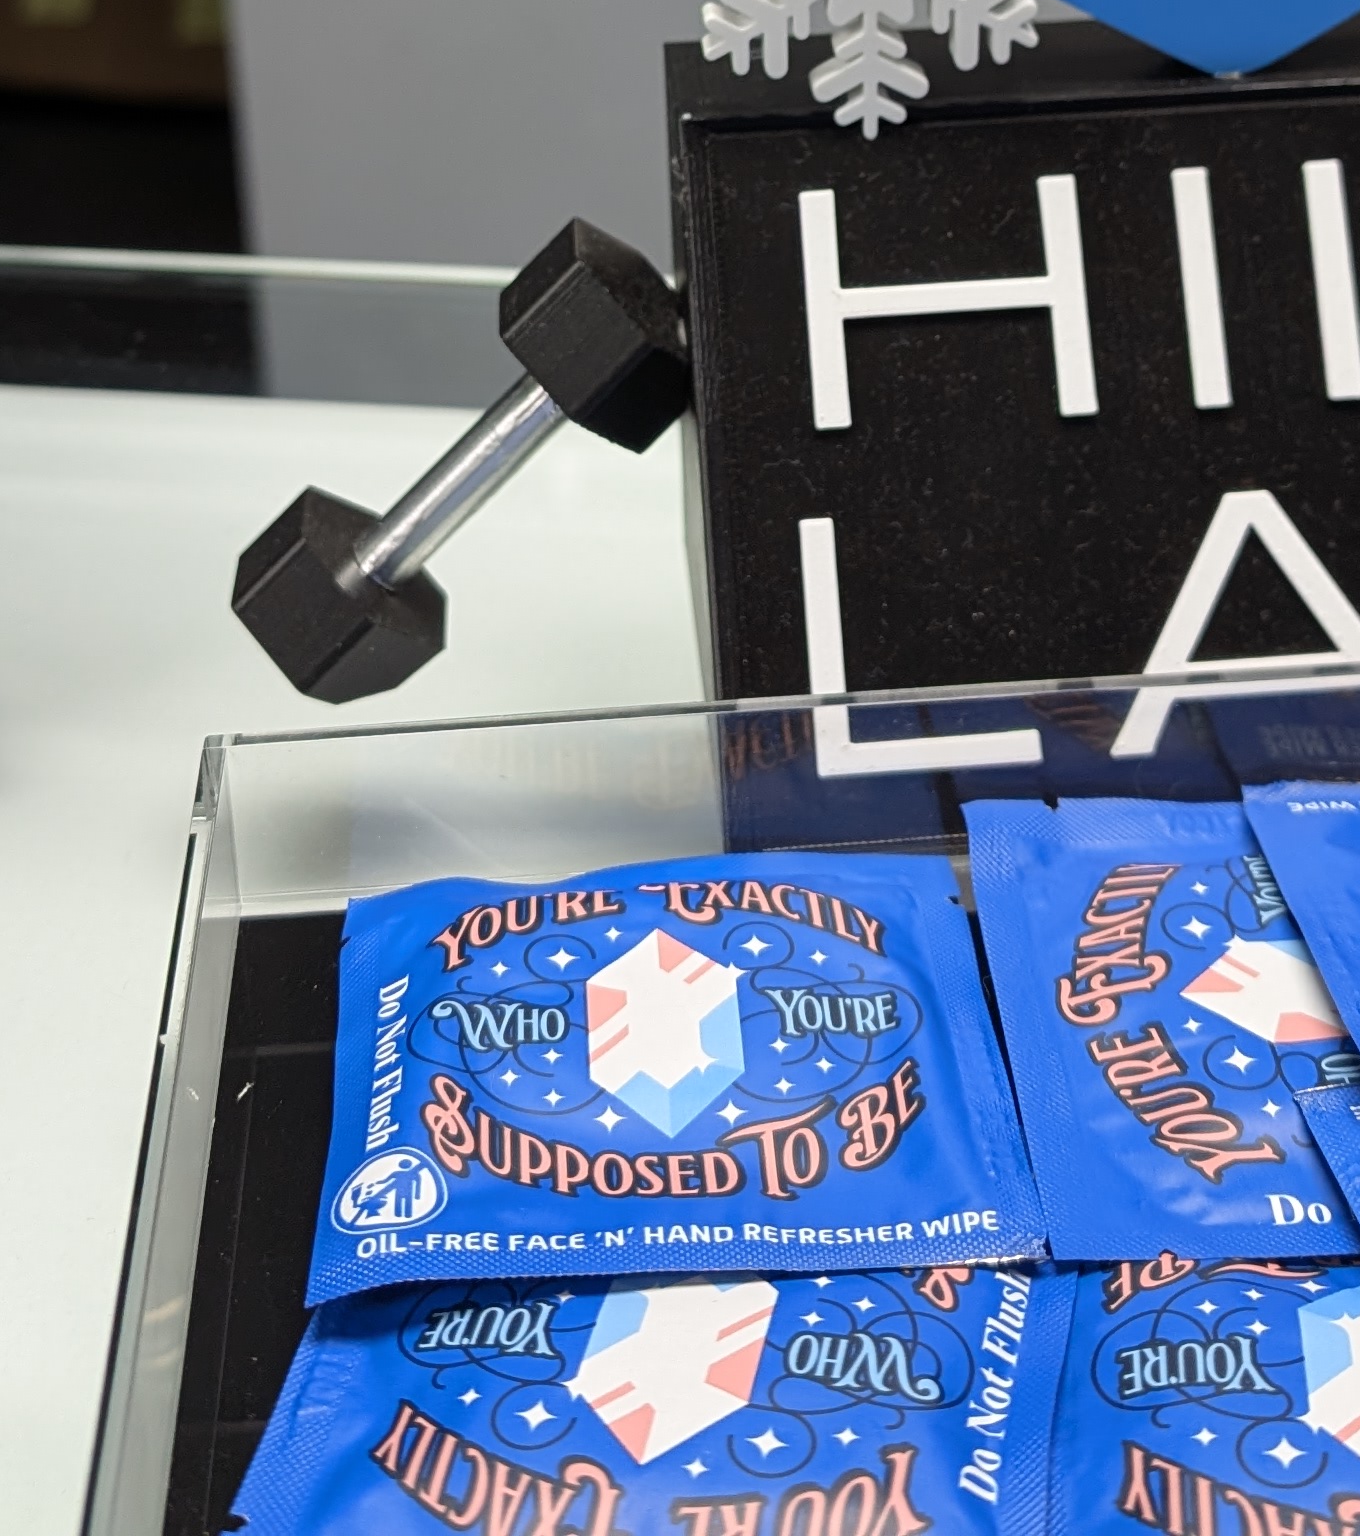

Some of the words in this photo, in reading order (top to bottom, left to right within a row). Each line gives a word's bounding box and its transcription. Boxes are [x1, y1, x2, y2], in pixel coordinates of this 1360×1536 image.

[1287, 800, 1358, 813] WIPE
[431, 890, 621, 971] YOU'RE
[637, 881, 886, 954] EXACTLY
[377, 973, 409, 1020] Do
[765, 988, 898, 1036] YOU'RE
[373, 1016, 407, 1071] Not
[432, 1000, 565, 1051] WHO
[365, 1066, 403, 1153] Flush
[424, 1076, 740, 1196] SUPPOSED
[717, 1100, 830, 1199] TO
[839, 1060, 922, 1168] BE
[1091, 1026, 1277, 1182] YOU'RE
[356, 1231, 500, 1259] OIL-FREE
[508, 1232, 586, 1252] FACE
[643, 1224, 734, 1245] HAND
[742, 1221, 914, 1246] REFRESHER
[920, 1210, 1000, 1239] WIPE
[1265, 1194, 1332, 1227] Do
[418, 1301, 560, 1356] YOU'RE
[787, 1332, 942, 1402] WHO
[1120, 1335, 1278, 1397] YOU'RE
[966, 1367, 1017, 1440] Not
[958, 1448, 1002, 1505] Do
